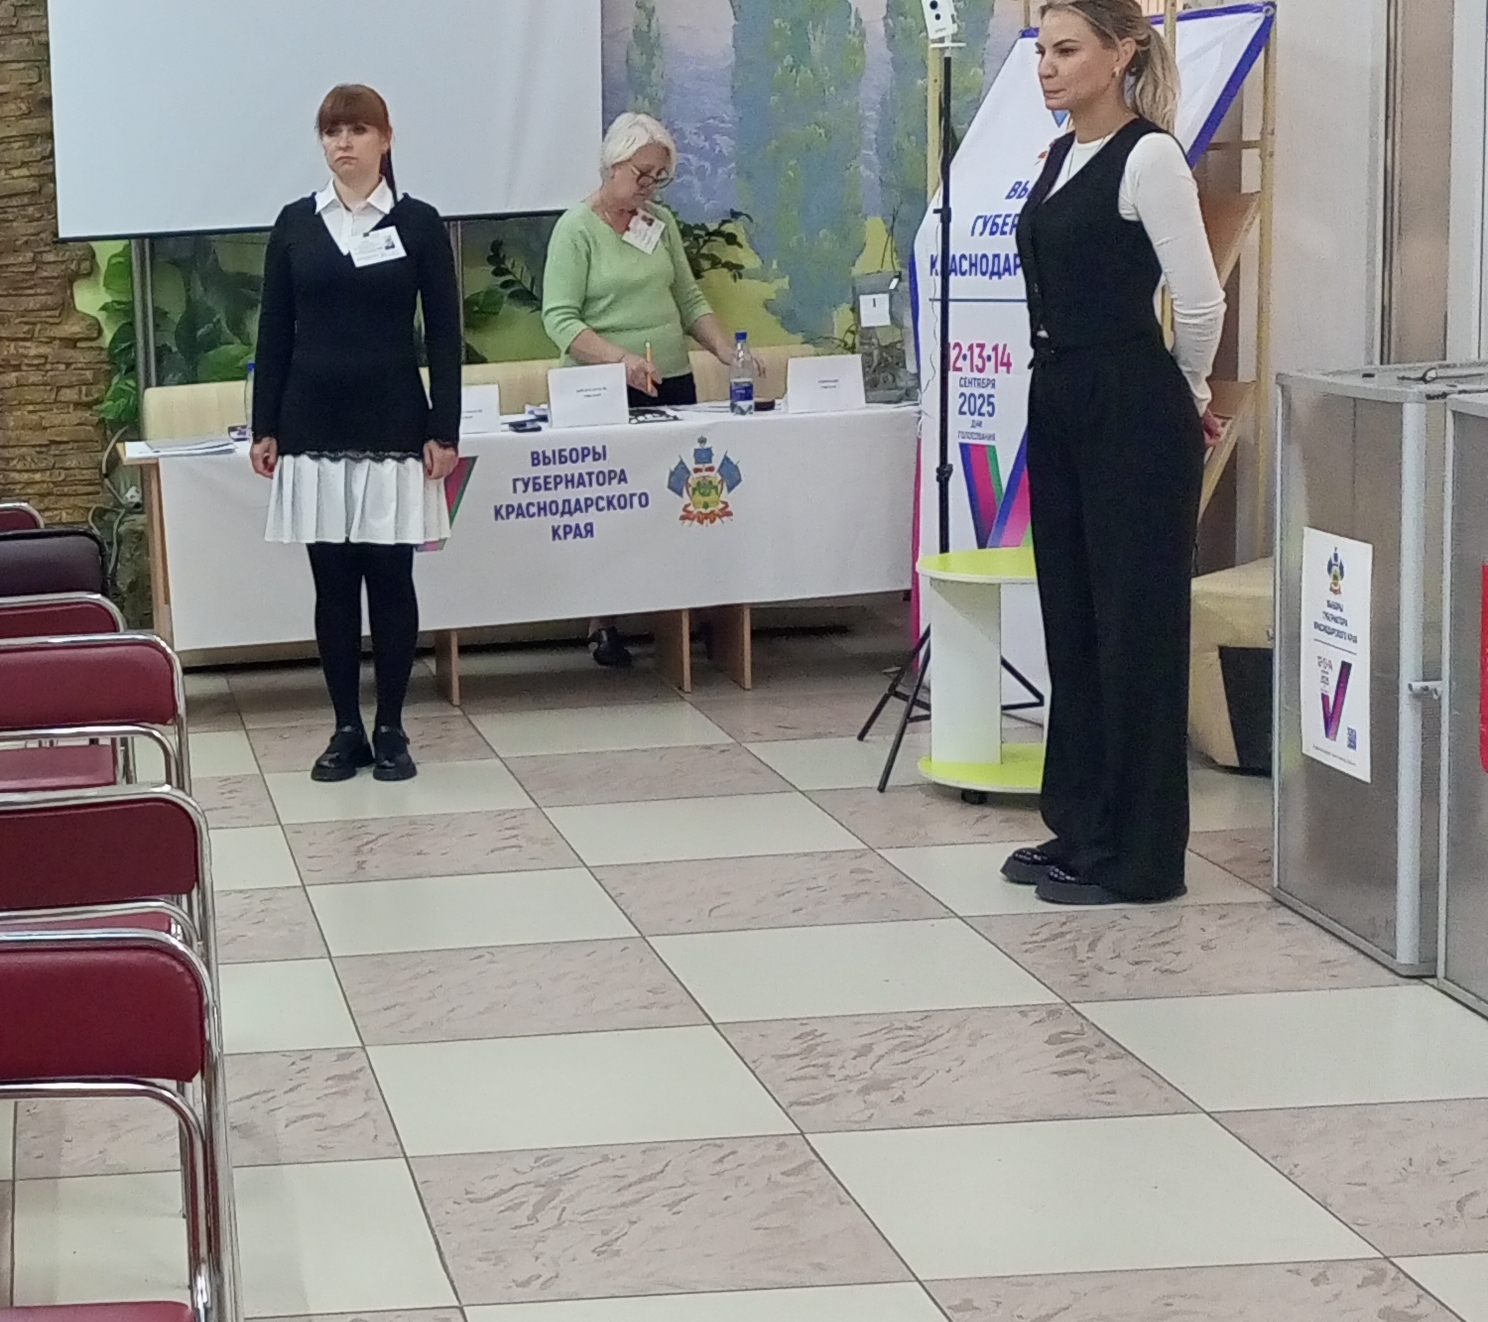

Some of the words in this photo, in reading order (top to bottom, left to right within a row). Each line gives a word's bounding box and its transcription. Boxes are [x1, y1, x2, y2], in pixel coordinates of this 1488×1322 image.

[958, 376, 996, 389] СЕНТЯБРЯ
[958, 391, 996, 418] 2025
[530, 445, 607, 467] ВЫБОРЫ
[512, 468, 629, 494] ГУБЕРНАТОРА
[494, 491, 650, 521] КРАСНОДАРСКОГО
[551, 522, 595, 542] КРАЯ
